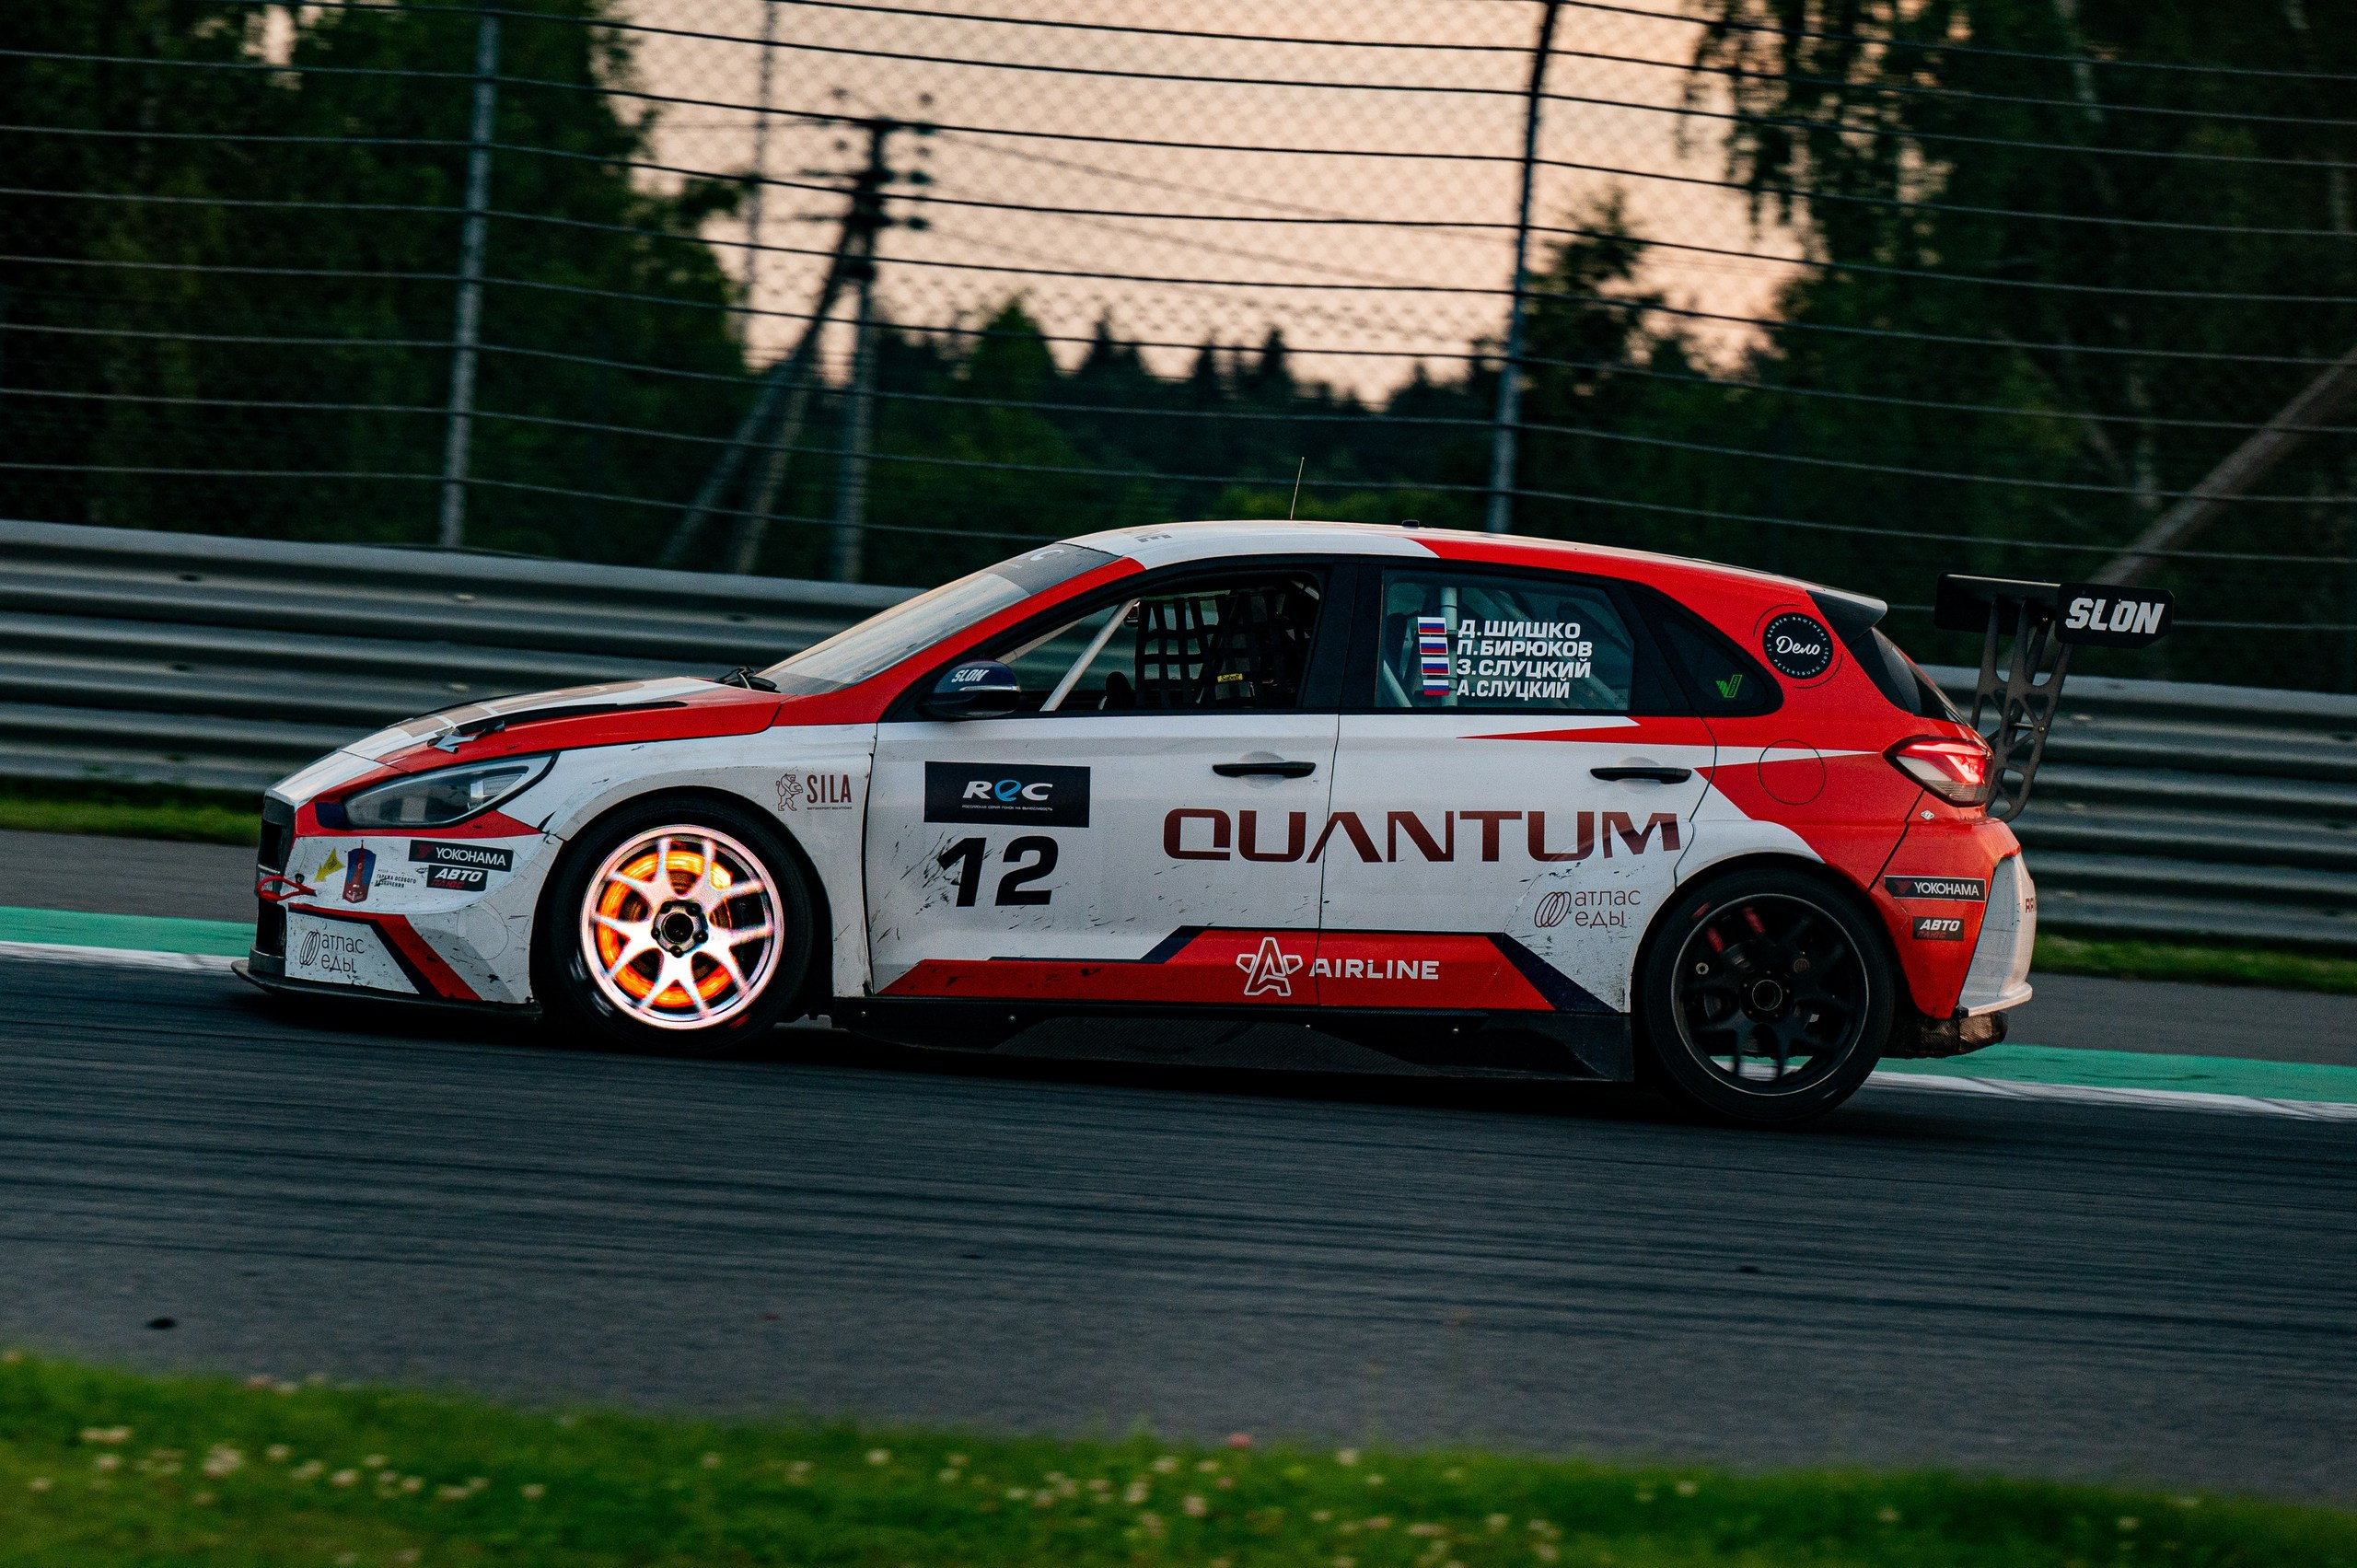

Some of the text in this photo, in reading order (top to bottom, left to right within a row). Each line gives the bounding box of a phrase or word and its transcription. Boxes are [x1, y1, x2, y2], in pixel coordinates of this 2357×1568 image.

[2065, 598, 2165, 634] SLON
[1457, 620, 1581, 639] Д.ШИШКО
[1457, 639, 1593, 657] П.БИРЮКОВ
[1776, 635, 1820, 655] Дело
[951, 669, 990, 682] SLON
[1457, 658, 1592, 679] З.СЛУЦКИЙ
[1457, 678, 1570, 701] А.СЛУЦКИЙ
[807, 774, 852, 804] SILA
[1164, 808, 1680, 863] QUANTUM
[435, 847, 506, 865] YOKOHAMA
[435, 868, 483, 882] АВТО
[936, 835, 1059, 908] 12
[1574, 890, 1641, 906] атлас
[1914, 882, 1980, 897] YOKOHAMA
[1574, 910, 1624, 928] еды
[1920, 919, 1960, 931] АВТО
[321, 934, 365, 954] атлас
[321, 954, 355, 973] еды
[1309, 958, 1439, 980] AIRLINE
